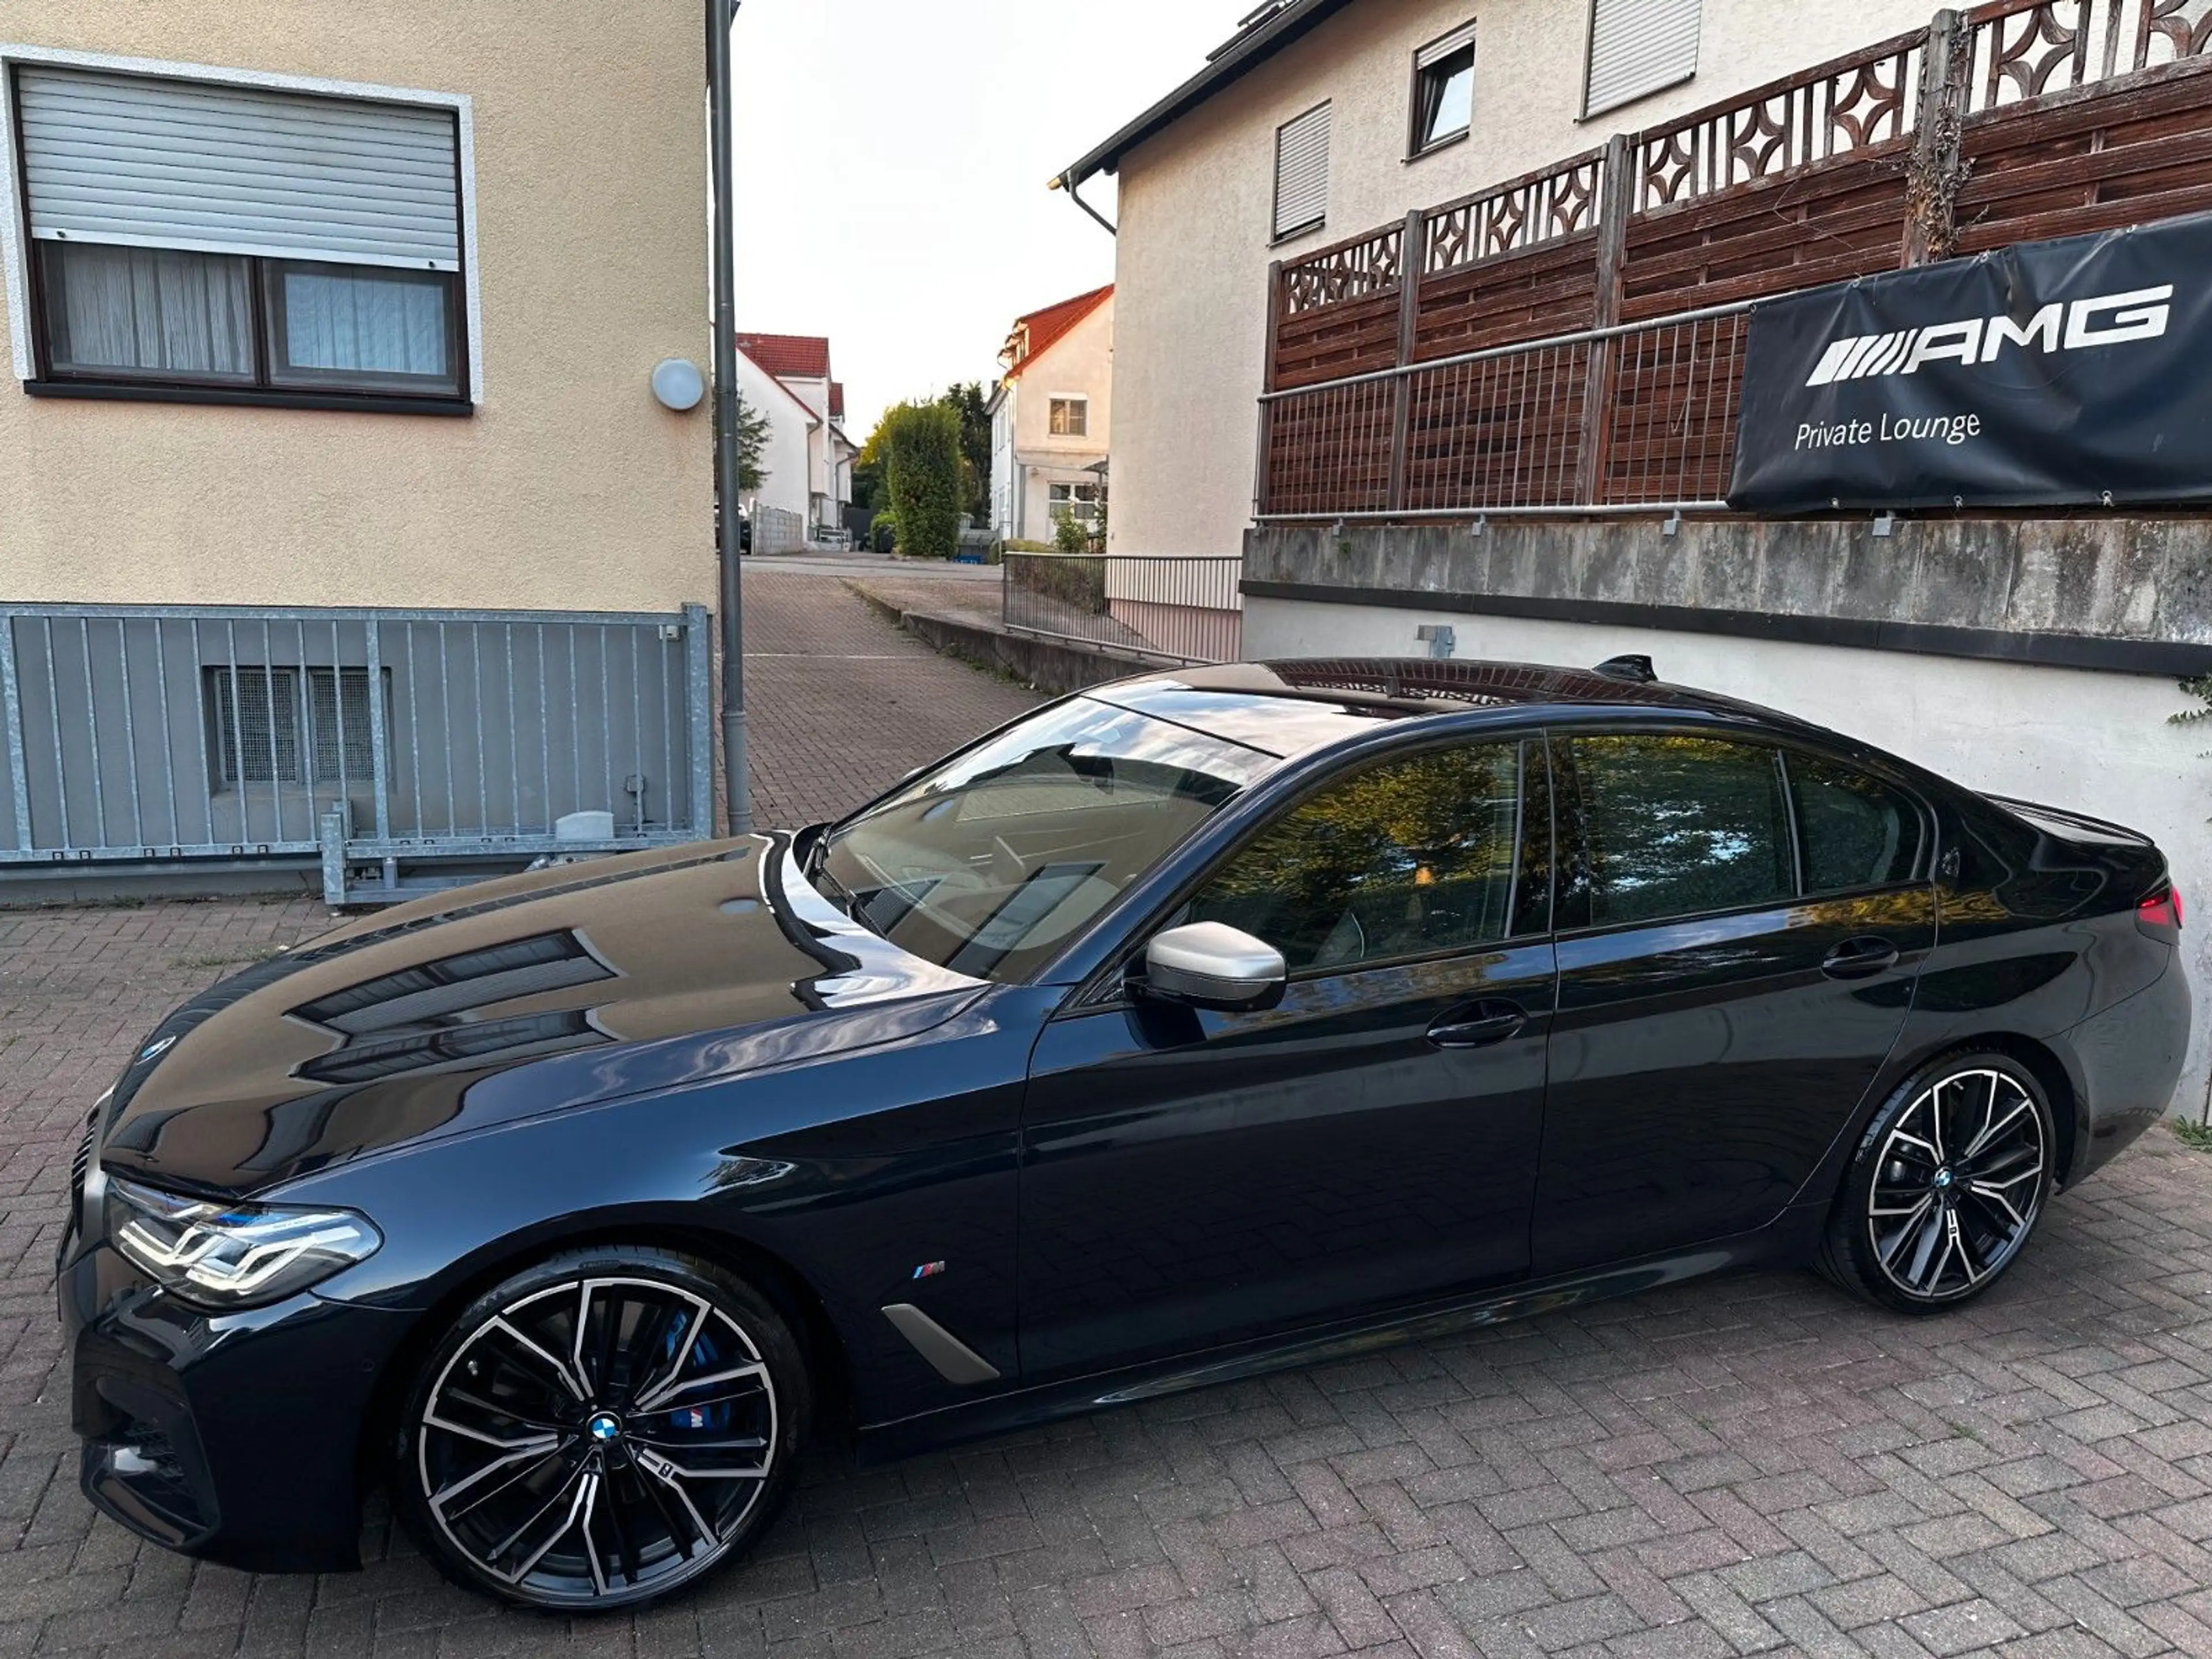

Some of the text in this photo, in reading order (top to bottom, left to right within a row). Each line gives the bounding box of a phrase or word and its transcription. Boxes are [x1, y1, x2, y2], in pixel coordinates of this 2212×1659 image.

[1900, 284, 2173, 374] AMG
[1794, 412, 1980, 450] Private Lounge
